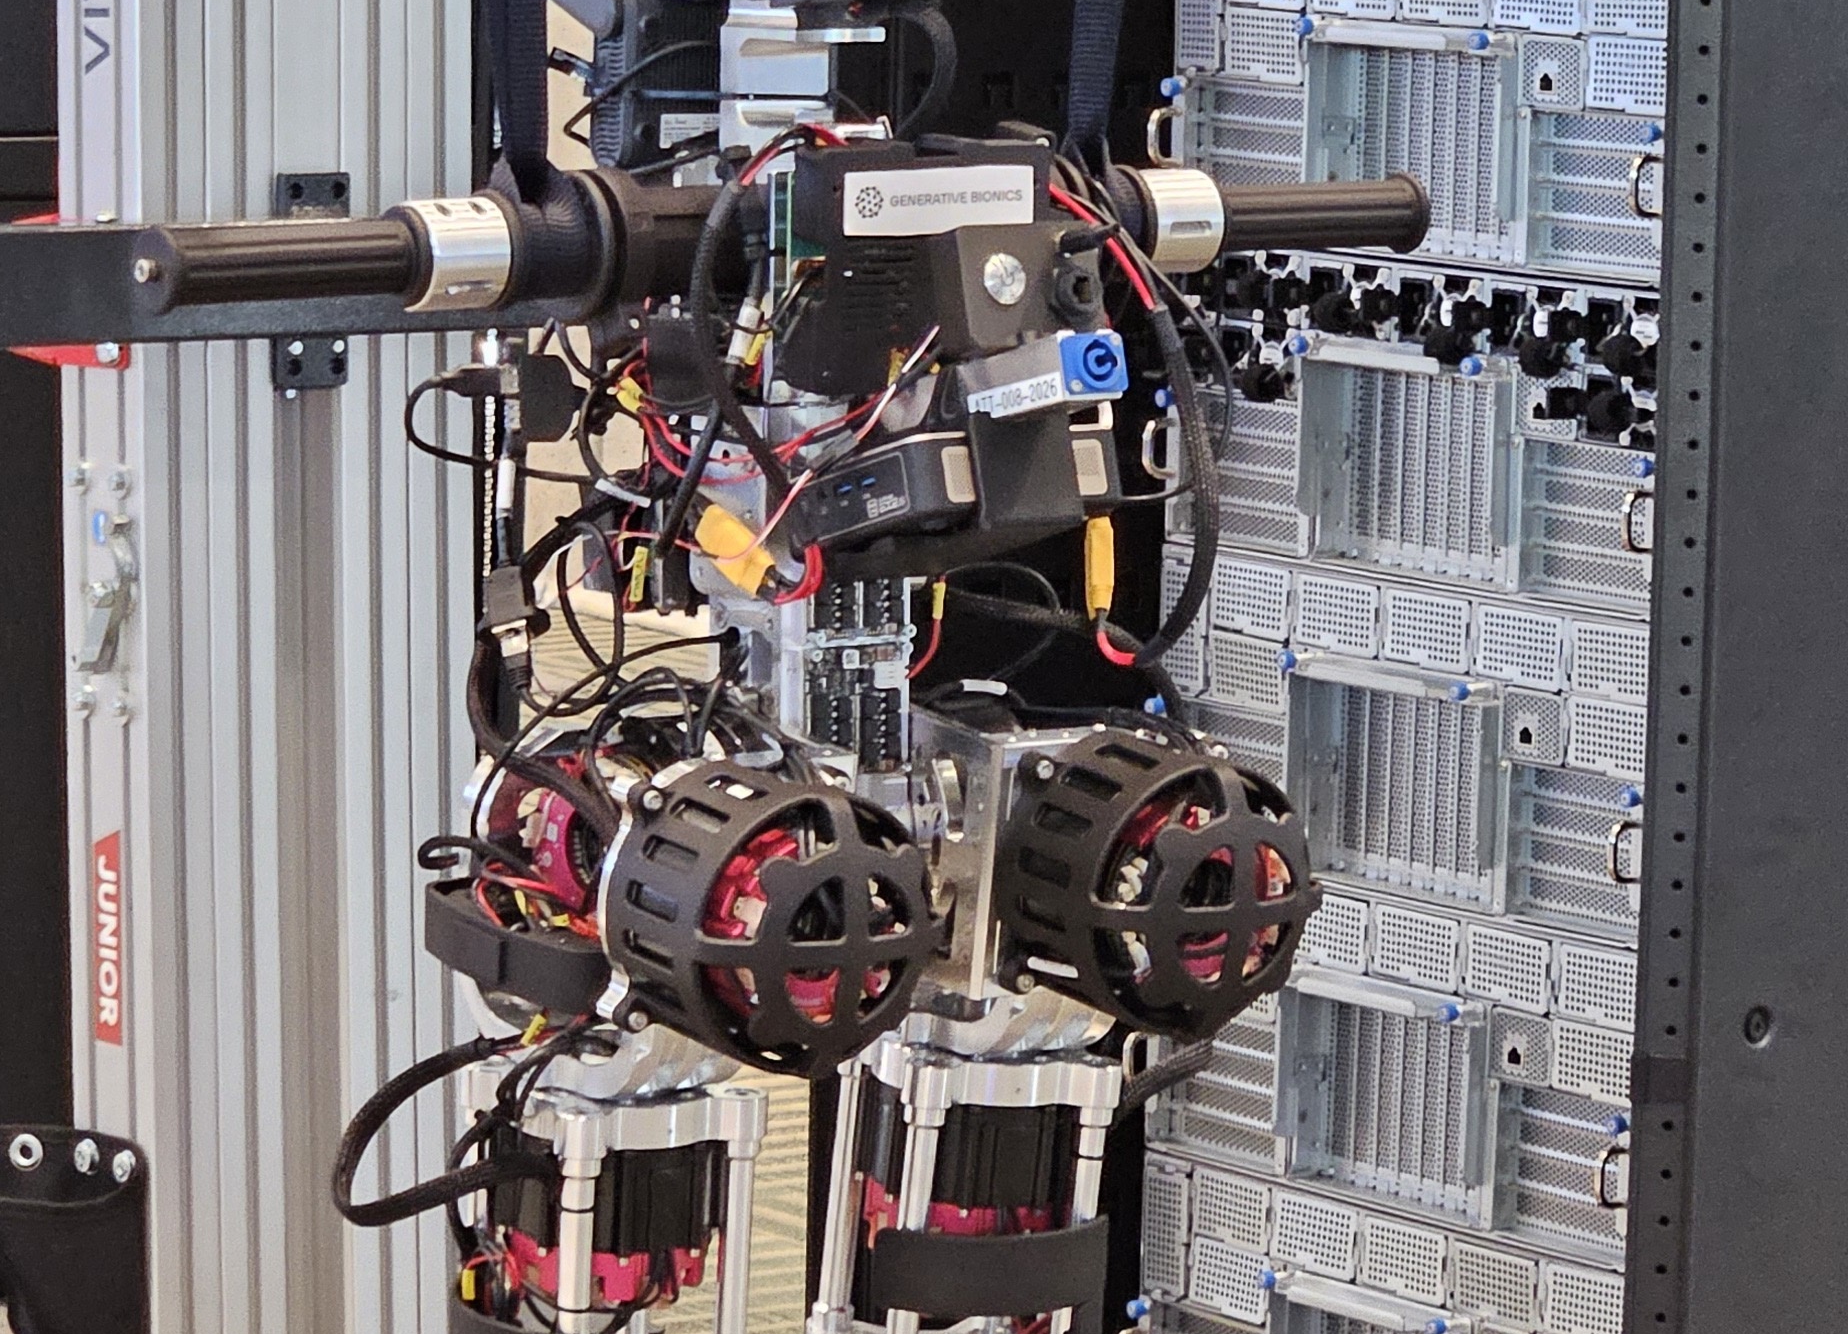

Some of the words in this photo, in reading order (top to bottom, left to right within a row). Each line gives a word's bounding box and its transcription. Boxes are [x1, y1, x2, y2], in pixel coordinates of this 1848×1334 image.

[889, 191, 968, 208] GENERATIVE
[970, 189, 1023, 204] BIONICS
[97, 854, 119, 1027] JUNIOR
